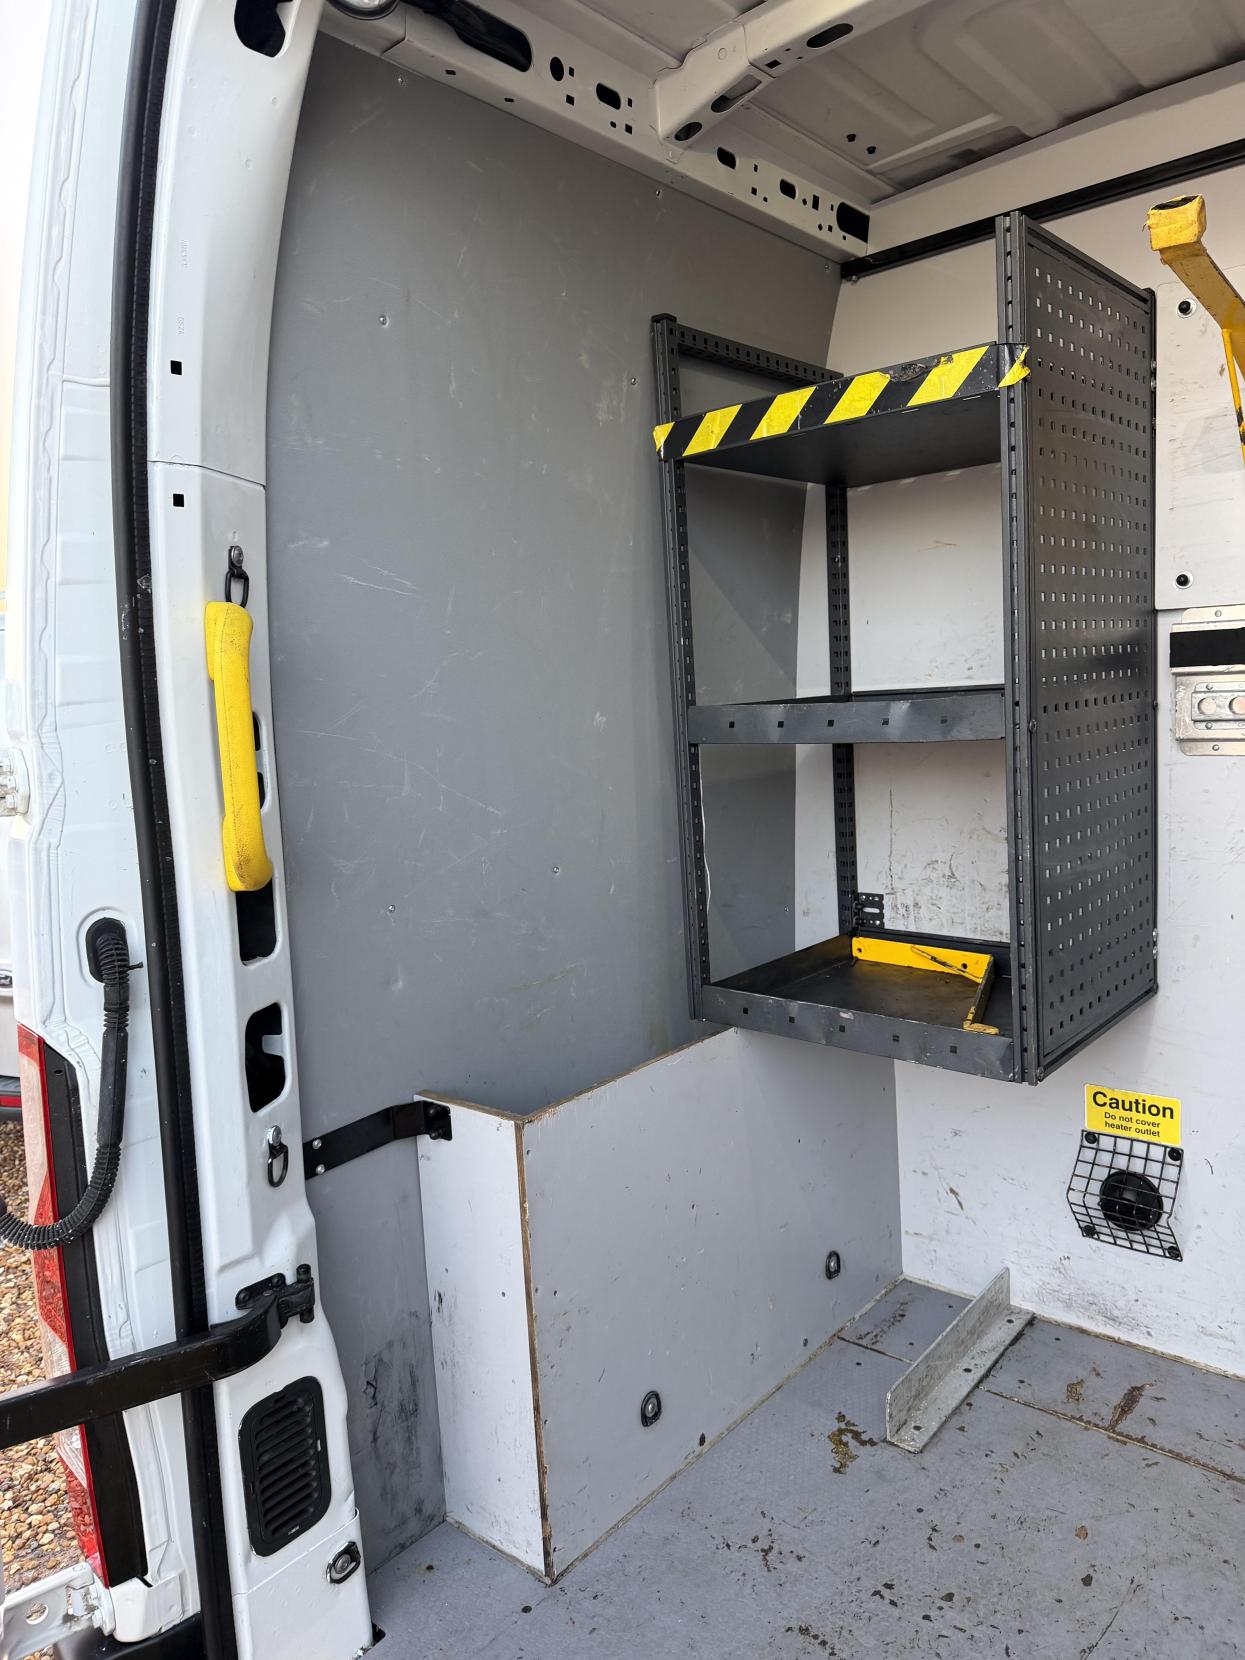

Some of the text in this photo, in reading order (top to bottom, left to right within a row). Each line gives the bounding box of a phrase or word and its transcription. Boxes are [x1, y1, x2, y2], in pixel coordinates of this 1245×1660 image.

[1093, 1091, 1174, 1119] Caution
[1104, 1112, 1160, 1128] Do not cover
[1104, 1121, 1160, 1137] heater outlet
